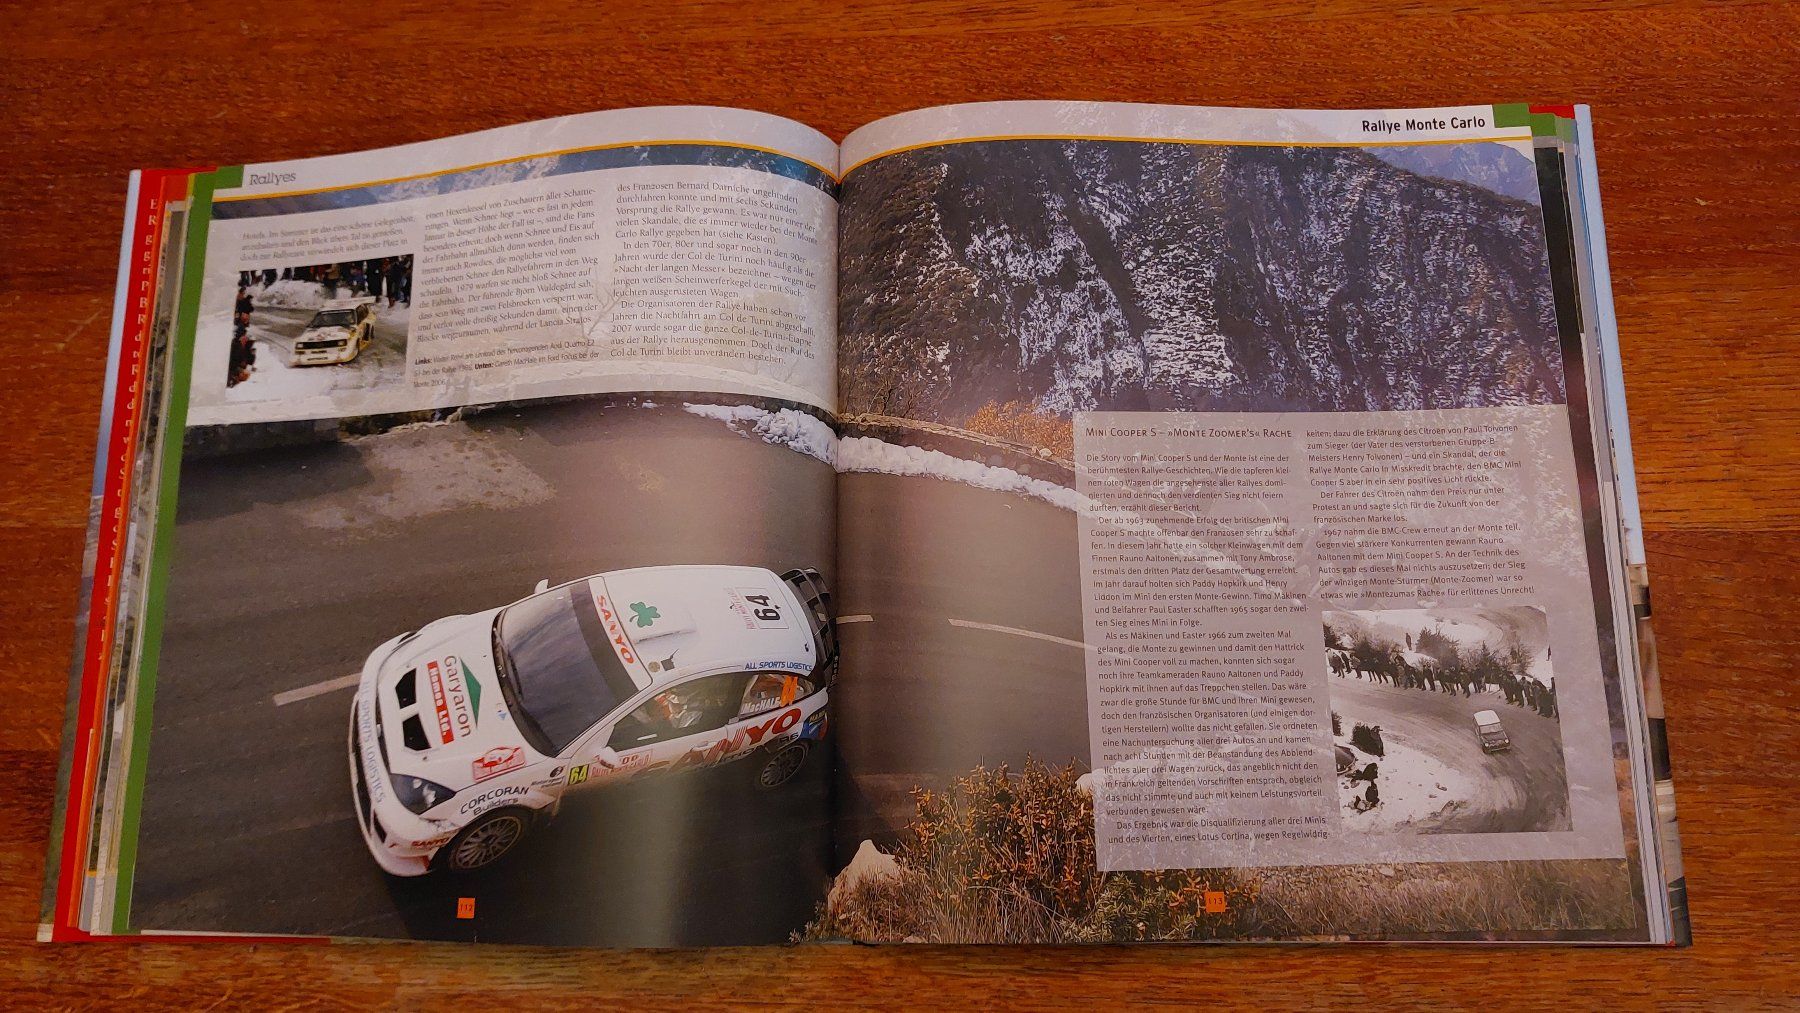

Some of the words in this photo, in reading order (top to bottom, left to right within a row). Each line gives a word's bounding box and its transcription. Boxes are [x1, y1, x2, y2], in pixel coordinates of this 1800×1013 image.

[1363, 120, 1400, 134] Rallye
[1406, 118, 1446, 131] Monte
[1451, 116, 1485, 129] Carlo
[250, 172, 296, 186] Rallyes
[616, 206, 658, 215] Vorsprung
[659, 204, 672, 212] die
[675, 204, 700, 214] Rallye
[702, 207, 737, 215] gewann.
[740, 208, 750, 216] Es
[769, 214, 783, 222] nur
[785, 216, 803, 228] einer
[803, 221, 817, 232] der
[615, 228, 637, 237] Carlo
[639, 227, 663, 238] Rallye
[665, 227, 700, 238] gegeben
[703, 228, 716, 236] hat
[718, 228, 743, 239] (siehe
[623, 240, 632, 248] In
[633, 240, 649, 248] den
[651, 239, 672, 248] 70er,
[674, 239, 694, 247] 80er
[696, 240, 715, 248] und
[714, 242, 738, 251] sogar
[740, 245, 762, 253] noch
[762, 246, 772, 255] in
[773, 248, 788, 258] den
[610, 347, 624, 356] Col
[625, 347, 637, 356] de
[639, 346, 664, 355] Turini
[666, 346, 692, 355] bleibt
[746, 350, 786, 364] bestehen.
[474, 362, 494, 370] Unten:
[1085, 428, 1106, 436] MINI
[1108, 428, 1147, 436] COOPER
[1167, 429, 1206, 437] »MONTE
[1208, 429, 1260, 437] ZOOMER'S«
[1262, 429, 1291, 437] RACHE
[1100, 453, 1120, 463] Story
[1156, 453, 1185, 463] Cooper
[1185, 453, 1191, 461] S
[1223, 453, 1246, 461] Monte
[1276, 454, 1288, 462] der
[1088, 503, 1119, 512] durften,
[1120, 502, 1147, 511] erzählt
[1148, 502, 1173, 511] dieser
[1172, 502, 1201, 511] Bericht.
[1312, 502, 1340, 511] Protest
[1352, 502, 1368, 510] und
[1369, 502, 1390, 511] sagte
[1392, 501, 1408, 509] sich
[1410, 500, 1421, 508] für
[1422, 500, 1436, 508] die
[1436, 499, 1468, 508] Zukunft
[1484, 498, 1499, 506] der
[1323, 527, 1341, 537] 1967
[1343, 527, 1365, 535] nahm
[1366, 526, 1379, 534] die
[1380, 526, 1420, 534] BMC-Crew
[1504, 522, 1520, 530] teil.
[1145, 553, 1181, 562] Aaltonen,
[1239, 553, 1257, 563] Tony
[1258, 553, 1294, 562] Ambrose,
[1092, 566, 1125, 574] erstmals
[1127, 566, 1142, 574] den
[1143, 566, 1169, 574] dritten
[1171, 566, 1189, 574] Platz
[1191, 566, 1205, 574] der
[1204, 566, 1265, 576] Gesamtwertung
[1266, 565, 1298, 574] erreicht.
[1344, 590, 1358, 598] wie
[1447, 587, 1458, 596] für
[1460, 587, 1498, 595] erlittenes
[1500, 585, 1534, 594] Unrecht!
[745, 595, 780, 620] 64
[597, 594, 634, 664] SANYO
[1109, 618, 1127, 628] Sieg
[1129, 618, 1150, 626] eines
[1151, 618, 1168, 626] Mini
[1170, 618, 1177, 626] in
[1179, 617, 1202, 627] Folge.
[1105, 631, 1117, 639] Als
[1130, 630, 1163, 639] Mäkinen
[1165, 630, 1180, 639] und
[1181, 630, 1206, 639] Easter
[1208, 630, 1226, 640] 1966
[1245, 629, 1274, 638] zweiten
[1276, 629, 1291, 638] Mal
[787, 662, 812, 670] LOGISTICS
[1099, 684, 1130, 694] Hopkirk
[1132, 683, 1144, 692] mit
[1146, 683, 1168, 692] ihnen
[1170, 683, 1183, 691] auf
[1184, 683, 1198, 691] das
[1199, 682, 1240, 693] Treppchen
[1241, 682, 1269, 690] stellen.
[1271, 682, 1286, 690] Das
[1287, 681, 1306, 690] wäre
[430, 667, 441, 707] Homes
[438, 709, 450, 736] Ltd.
[444, 655, 472, 737] Garyaron
[360, 700, 372, 743] SPORTS
[366, 746, 386, 804] LOGISTICS
[570, 766, 588, 784] 64
[460, 786, 529, 815] CORCORAN
[473, 796, 518, 816] Builders
